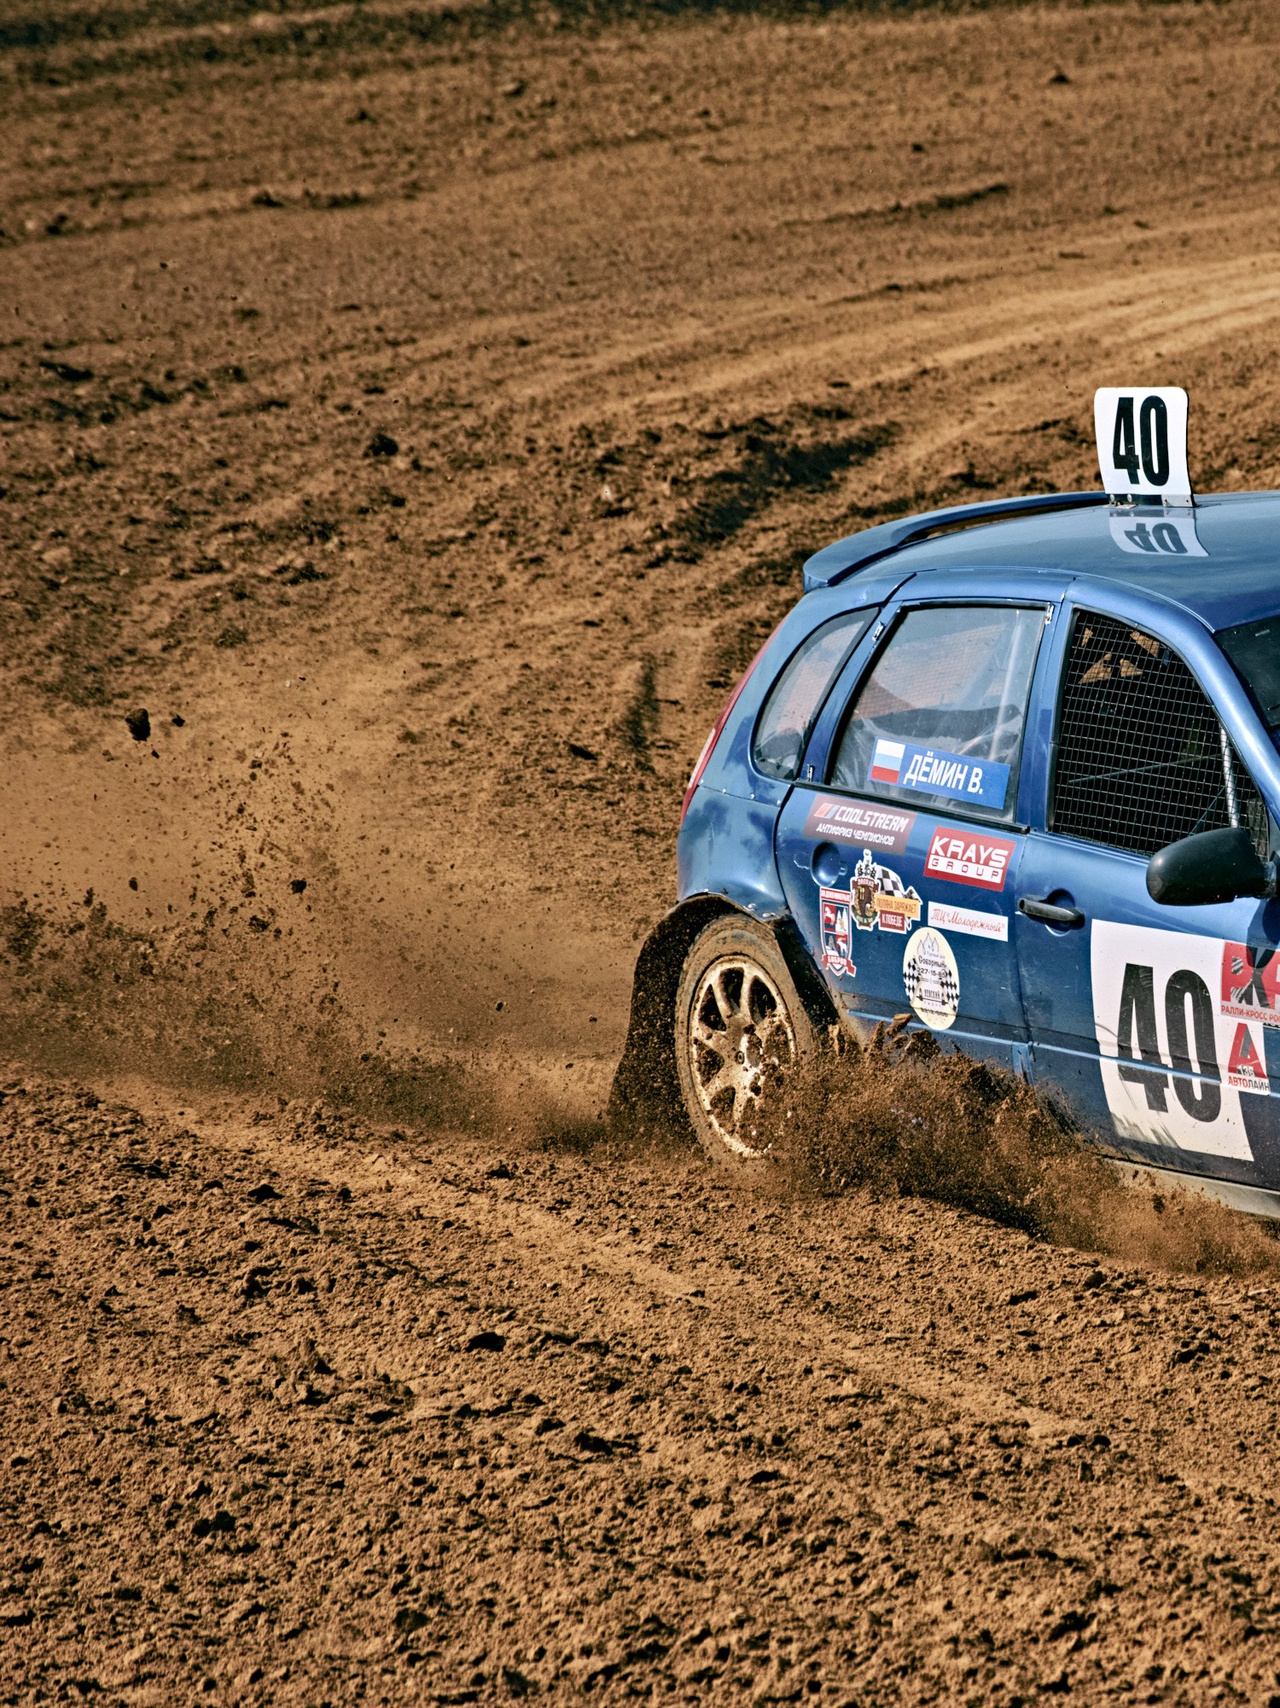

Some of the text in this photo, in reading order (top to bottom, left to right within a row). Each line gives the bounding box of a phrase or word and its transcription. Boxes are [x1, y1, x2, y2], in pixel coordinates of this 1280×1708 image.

[1112, 395, 1170, 487] 40
[903, 751, 983, 794] ДЁМИН В.
[834, 806, 910, 833] COOLSTREAM
[816, 823, 895, 846] АНТИФРИЗ ЧЕМПИОНОВ
[931, 835, 1009, 869] KRAYS
[931, 857, 1000, 879] GROUP
[1221, 1004, 1268, 1021] РАЛЛИ-КРОСС
[1117, 962, 1222, 1123] 40
[1228, 1075, 1270, 1092] АВТОЛАЙН
